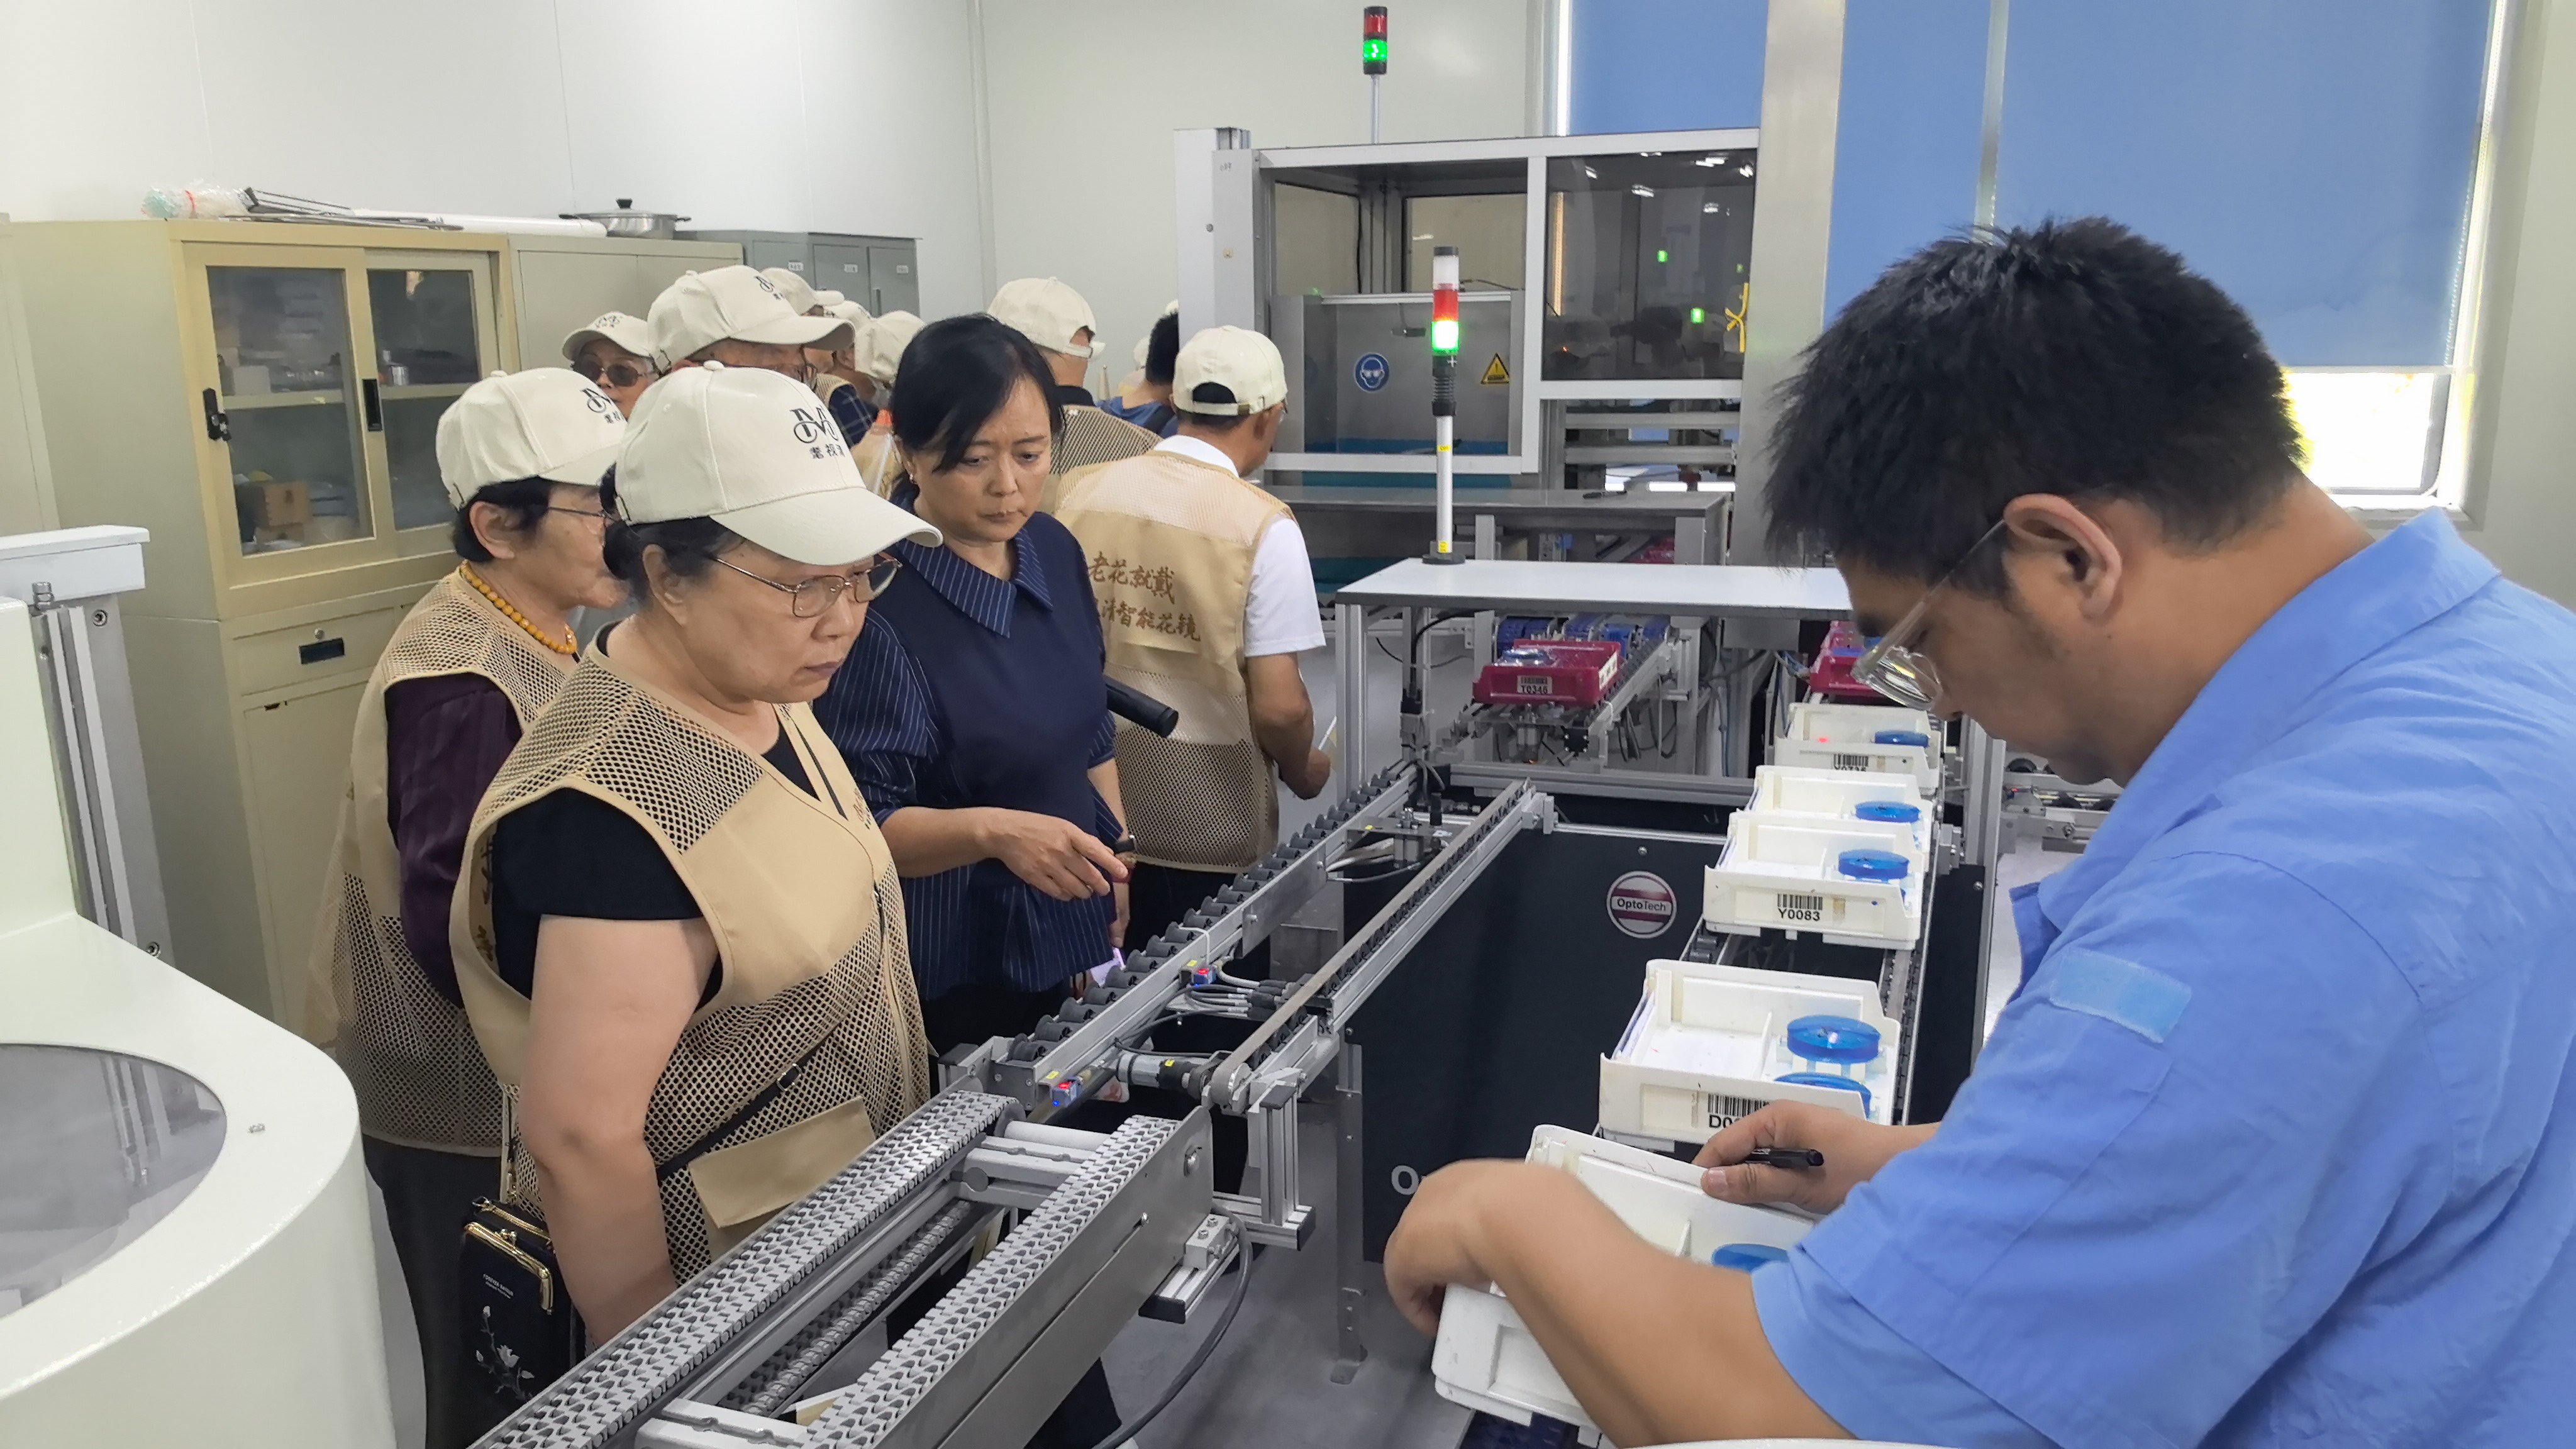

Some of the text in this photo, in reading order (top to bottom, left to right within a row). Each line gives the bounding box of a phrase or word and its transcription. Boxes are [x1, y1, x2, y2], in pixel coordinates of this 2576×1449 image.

[1095, 597, 1201, 641] 清智能花镜
[1617, 897, 1667, 912] OptoTech
[1777, 908, 1821, 922] Y0083
[1709, 1114, 1740, 1129] D0
[1391, 1165, 1425, 1195] O
